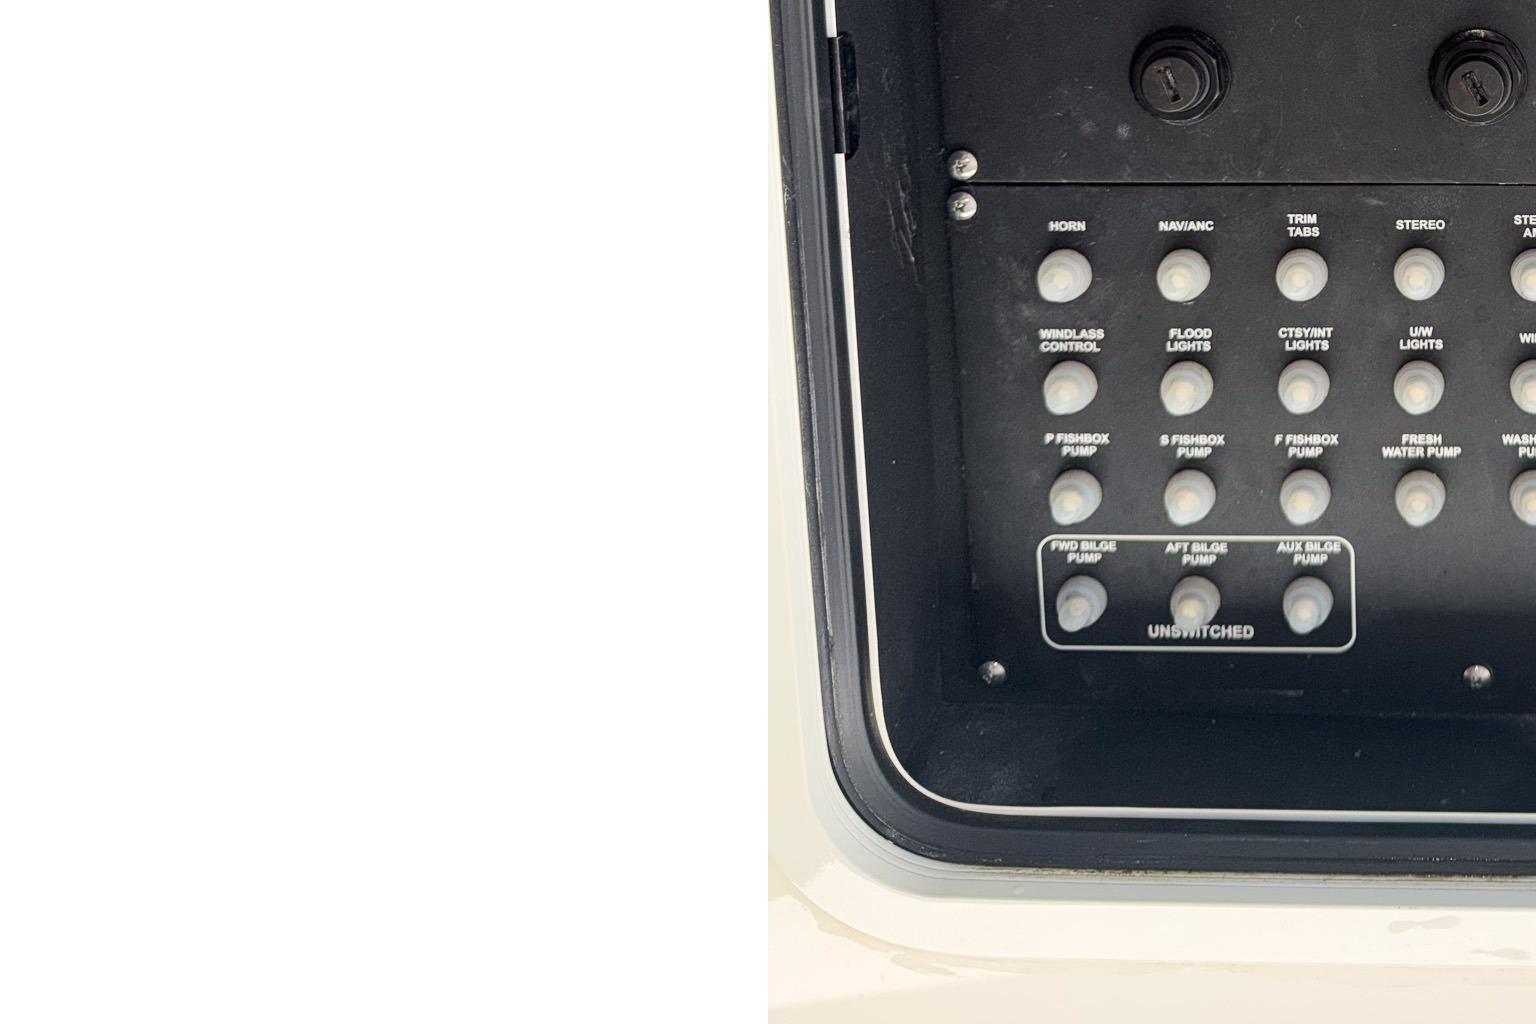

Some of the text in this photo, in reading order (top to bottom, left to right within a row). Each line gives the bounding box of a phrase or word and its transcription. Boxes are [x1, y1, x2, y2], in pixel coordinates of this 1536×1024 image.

[1286, 213, 1318, 225] TRIM
[1395, 219, 1446, 231] STEREO
[1048, 220, 1087, 232] HORN
[1158, 220, 1215, 232] NAV/ANC
[1286, 226, 1321, 238] TABS
[1038, 328, 1105, 341] WINDLASS
[1168, 327, 1213, 340] FLOOD
[1277, 326, 1334, 339] CTSY/INT
[1409, 325, 1434, 338] U/W
[1039, 340, 1102, 353] CONTROL
[1165, 340, 1212, 353] LIGHTS
[1284, 339, 1330, 352] LIGHTS
[1399, 338, 1444, 351] LIGHTS
[1044, 432, 1111, 445] P FISHBOX
[1159, 433, 1226, 447] S FISHBOX
[1274, 433, 1339, 446] F FISHBOX
[1401, 433, 1443, 446] FRESH
[1061, 445, 1098, 457] PUMP
[1176, 446, 1213, 459] PUMP
[1287, 445, 1324, 459] PUMP
[1381, 446, 1462, 459] WATER PUMP
[1050, 539, 1117, 552] FWD BILGE
[1164, 541, 1229, 554] AFT BILGE
[1276, 541, 1341, 554] AUX BILGE
[1066, 551, 1103, 564] PUMP
[1181, 552, 1217, 566] PUMP
[1293, 552, 1329, 566] PUMP
[1147, 624, 1255, 640] UNSWITCHED
